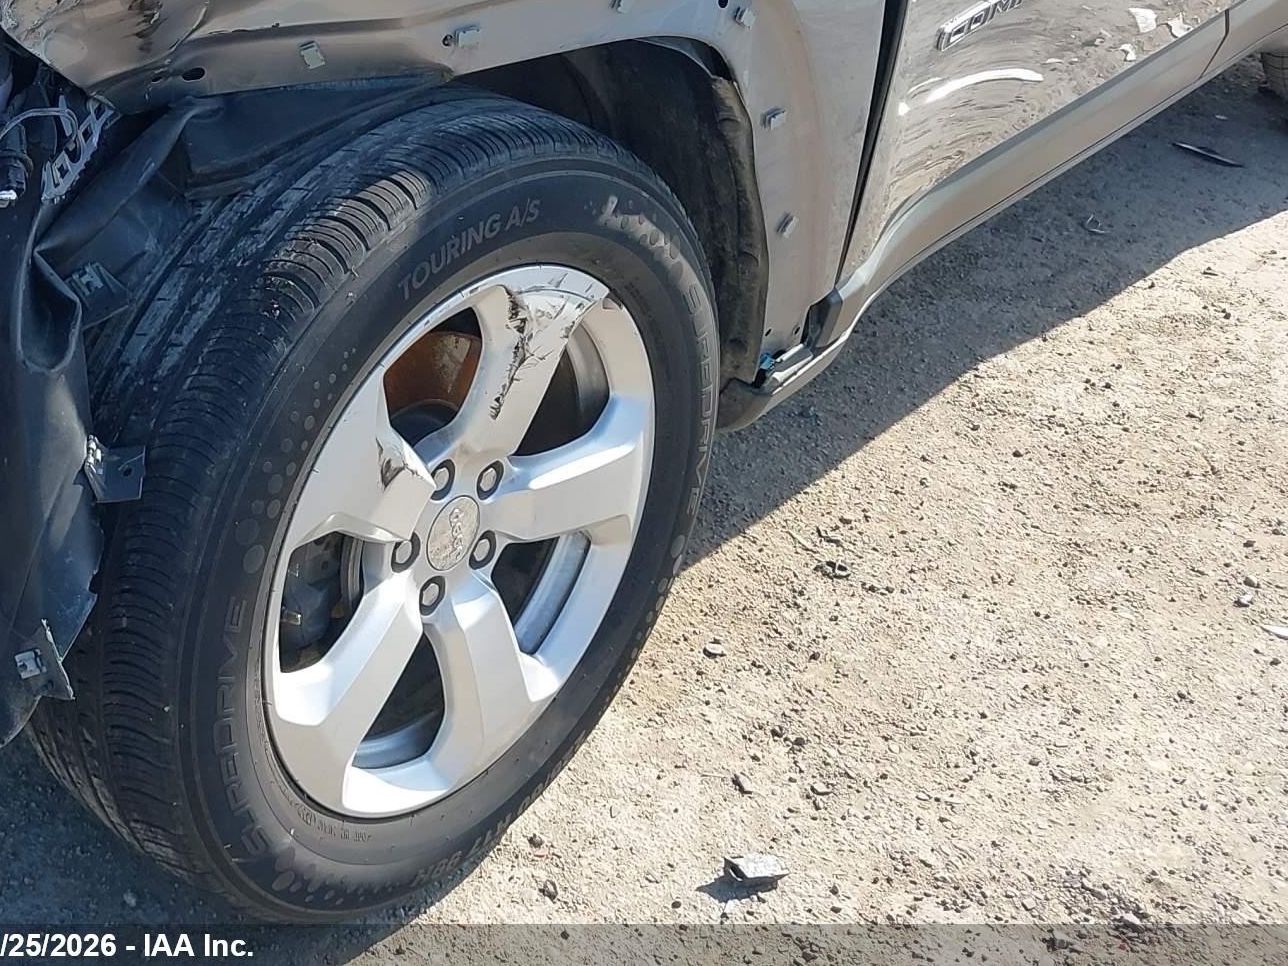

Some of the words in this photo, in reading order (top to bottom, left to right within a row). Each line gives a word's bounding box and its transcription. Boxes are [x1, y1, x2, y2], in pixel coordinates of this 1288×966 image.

[397, 211, 501, 301] TOURING
[505, 196, 541, 230] A/S
[214, 595, 270, 856] SUREDRIVE
